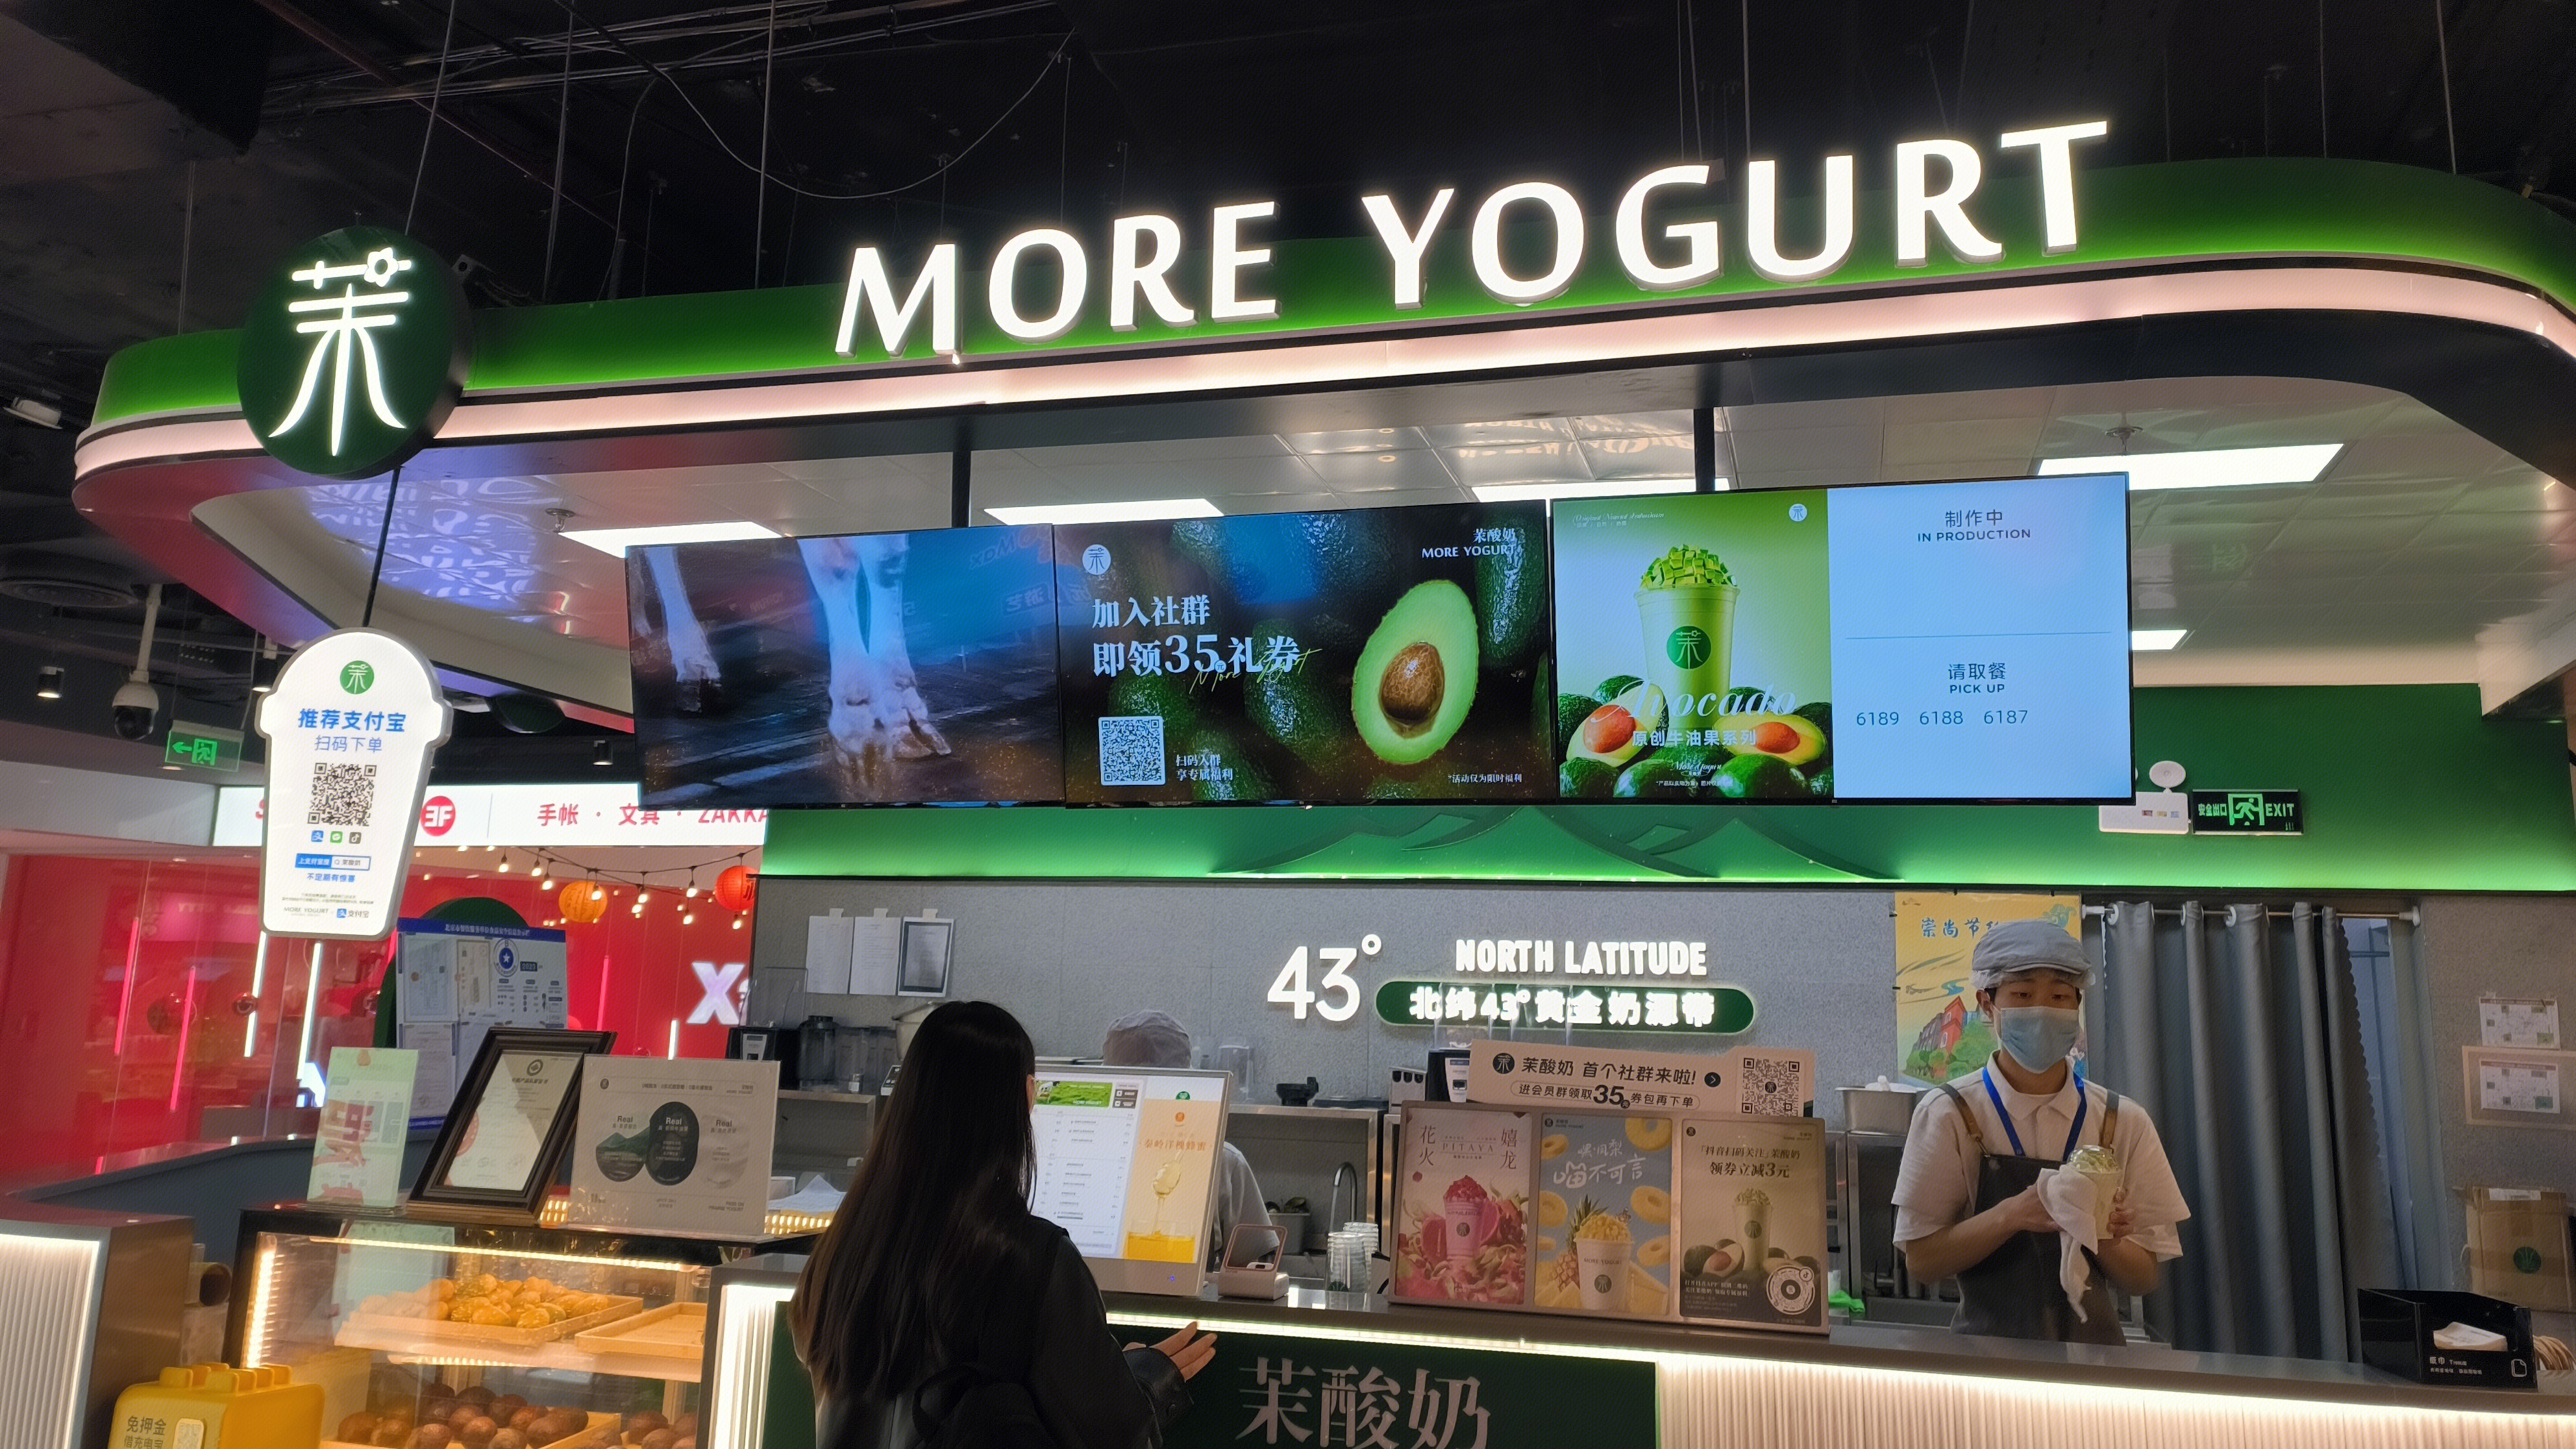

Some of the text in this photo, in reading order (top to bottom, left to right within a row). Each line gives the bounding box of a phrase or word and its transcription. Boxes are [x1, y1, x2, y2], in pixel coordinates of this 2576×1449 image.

[836, 120, 2109, 356] MORE YOGURT
[1945, 509, 2003, 528] 制作中
[1473, 528, 1516, 543] 茉酸奶
[1918, 528, 2031, 542] IN PRODUCTION
[1422, 545, 1516, 559] MORE YOGURT
[1092, 595, 1210, 629] 加入社群
[1948, 662, 2007, 681] 请取餐
[1950, 684, 2005, 694] PICK UP
[297, 708, 406, 733] 推荐支付宝
[1856, 710, 2028, 725] 6189 6188 6187
[314, 735, 382, 753] 扫码下单
[1631, 728, 1757, 747] 原创牛油果系列
[1176, 754, 1221, 767] 扫码入群
[1176, 767, 1233, 781] 享专属福利
[538, 803, 579, 826] 手帐
[2198, 803, 2294, 817] 安全出口 EXIT
[347, 910, 370, 919] 支付宝
[1455, 939, 1707, 976] NORTH LATITUDE
[1522, 1057, 1574, 1076] 茉酸奶
[1583, 1061, 1697, 1085] 首个社群来啦!
[665, 1117, 682, 1125] Real
[715, 1119, 732, 1128] Real
[1442, 1142, 1494, 1153] PITAYA
[1552, 1153, 1646, 1189] 喵不可言
[1709, 1161, 1790, 1178] 领券立减3元
[1235, 1356, 1491, 1449] 茉酸奶
[127, 1415, 167, 1436] 免押金
